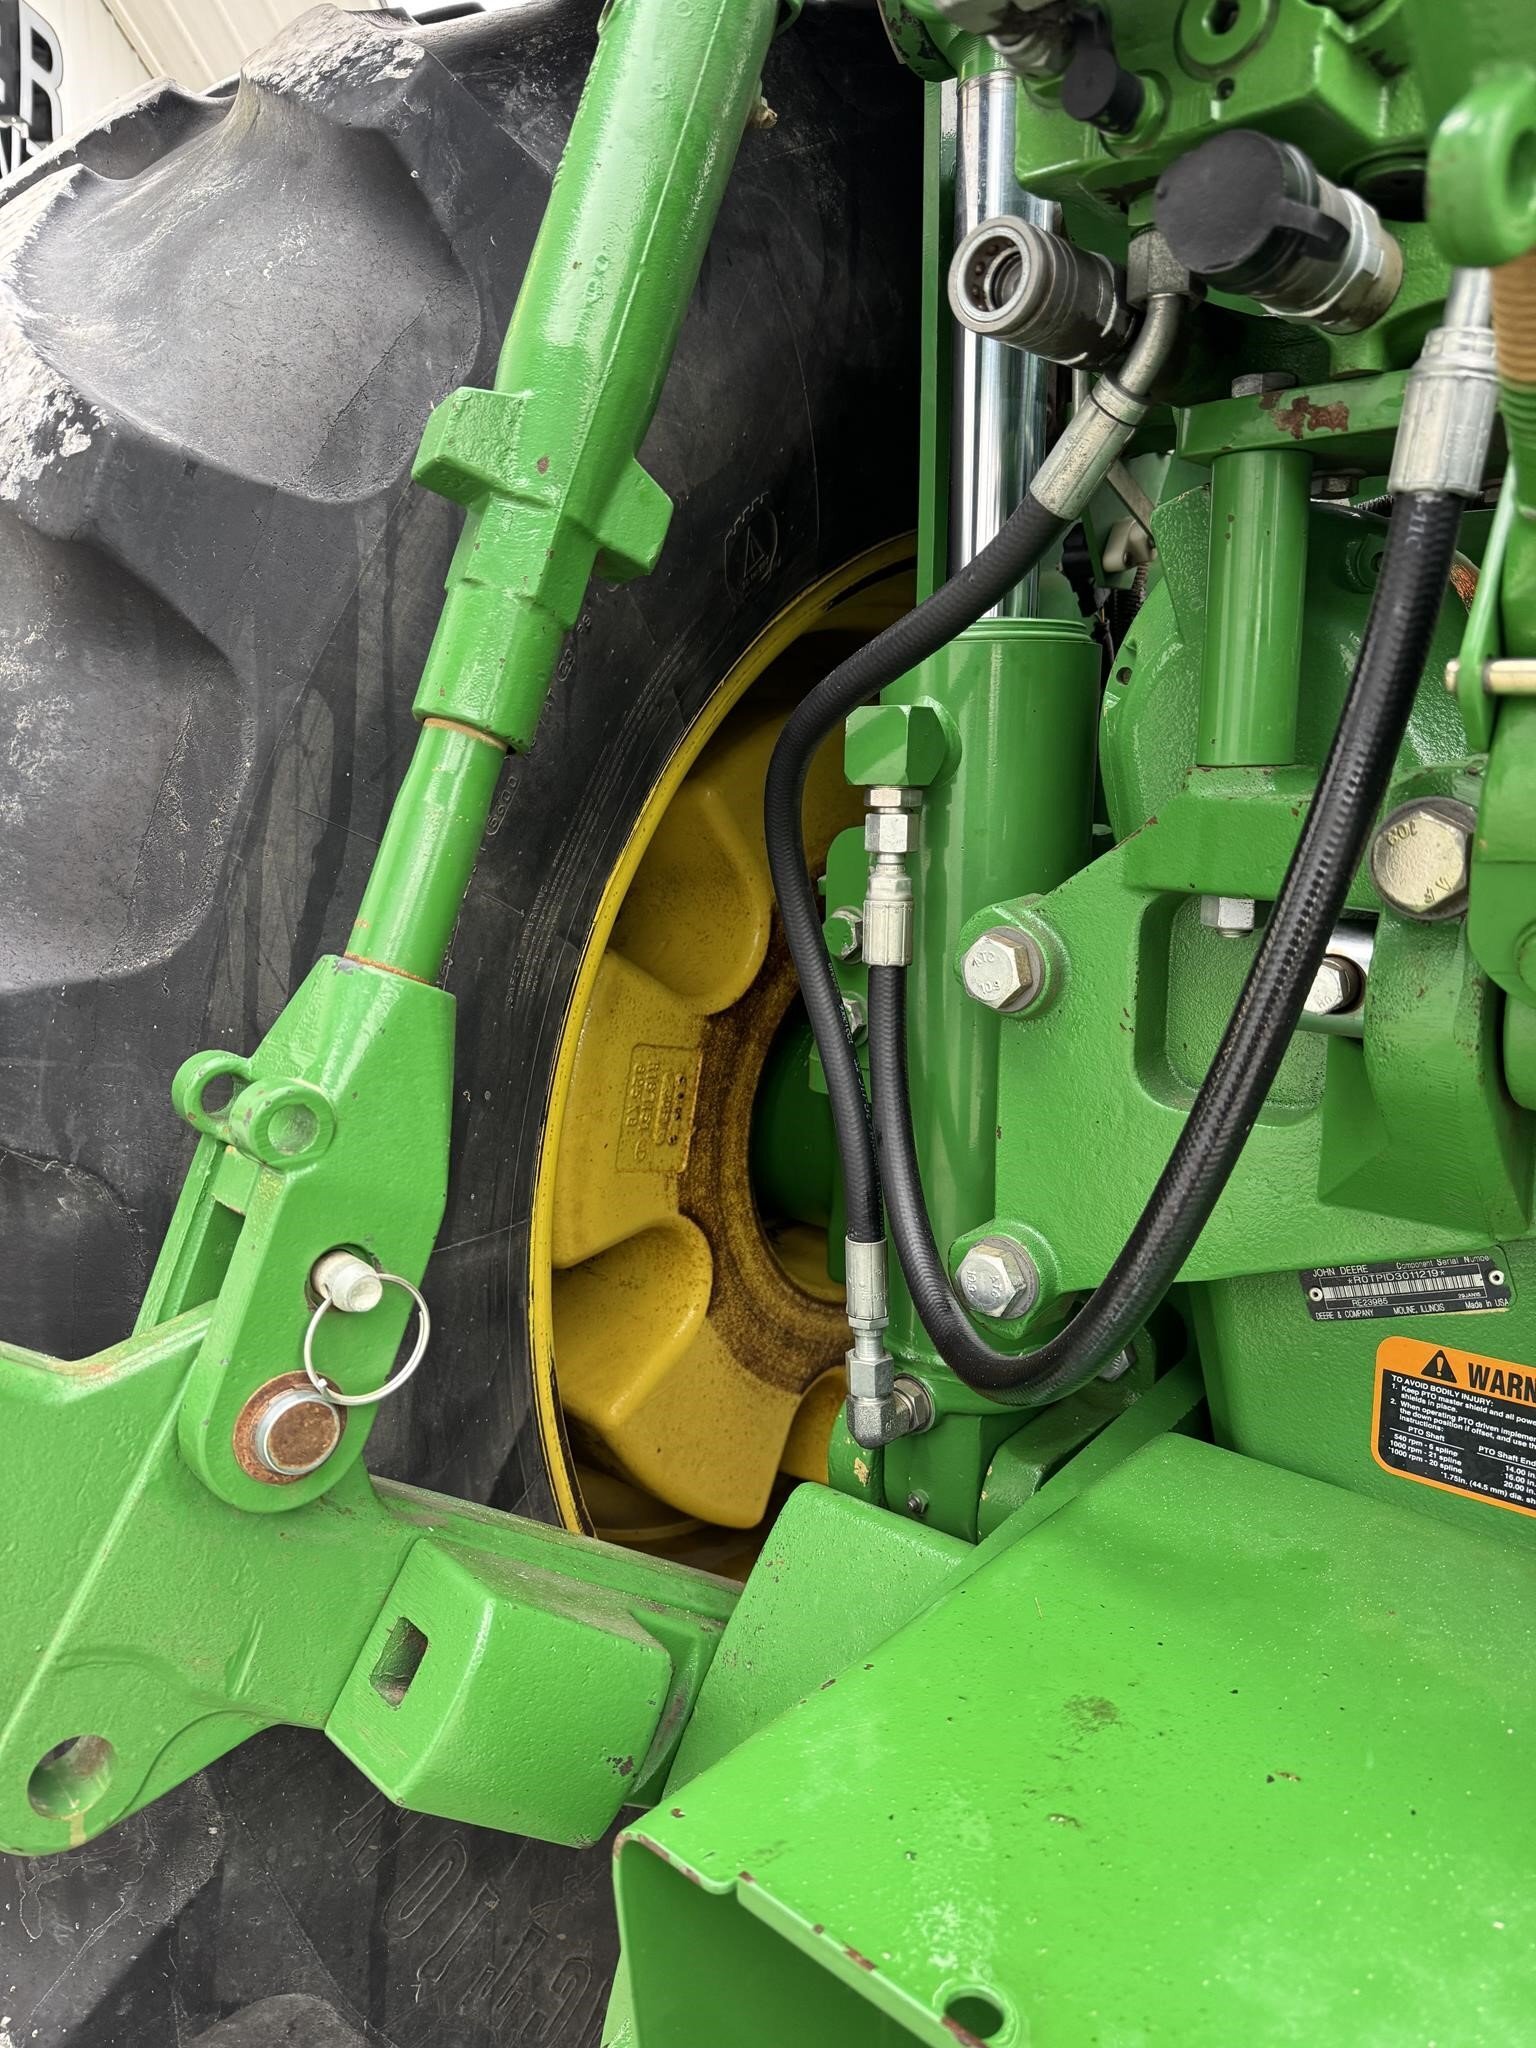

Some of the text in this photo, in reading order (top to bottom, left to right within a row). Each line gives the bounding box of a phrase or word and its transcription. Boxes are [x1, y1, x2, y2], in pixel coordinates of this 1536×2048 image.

[1313, 1265, 1368, 1277] JOHN DEERE
[1396, 1260, 1433, 1270] Component
[1437, 1258, 1459, 1266] Serial
[1420, 1303, 1445, 1313] ILLINOIS
[1465, 1301, 1482, 1309] Made
[1494, 1298, 1509, 1307] USA
[1315, 1311, 1334, 1320] DEERE
[1345, 1309, 1374, 1318] COMPANY
[1391, 1374, 1494, 1407] TO AVOID BODILY INJURY:
[1468, 1363, 1536, 1403] WARN
[1401, 1386, 1420, 1396] Keep
[1421, 1391, 1436, 1399] PTO
[1438, 1396, 1463, 1407] master
[1465, 1403, 1488, 1413] shield
[1489, 1409, 1504, 1417] and
[1401, 1393, 1426, 1403] shields
[1436, 1402, 1458, 1413] place.
[1399, 1414, 1444, 1431] instructions:
[1400, 1401, 1420, 1411] When
[1422, 1407, 1457, 1422] operating
[1458, 1416, 1474, 1425] PTO
[1475, 1421, 1500, 1432] driven
[1408, 1426, 1445, 1441] PTO Shaft
[1412, 1411, 1432, 1421] down
[1433, 1418, 1463, 1431] position
[1465, 1423, 1470, 1431] if
[1471, 1427, 1495, 1439] offset,
[1496, 1434, 1511, 1443] and
[1513, 1439, 1527, 1447] use
[1390, 1440, 1407, 1449] 1000
[1408, 1445, 1422, 1454] rpm
[1439, 1455, 1462, 1466] spline
[1394, 1433, 1407, 1442] 540
[1408, 1438, 1423, 1447] rpm
[1435, 1446, 1458, 1457] spline
[1478, 1446, 1495, 1455] PTO
[1497, 1451, 1518, 1462] Shaft
[1408, 1453, 1423, 1462] rpm
[1440, 1463, 1463, 1474] spline
[1505, 1465, 1526, 1476] 14.00
[1504, 1473, 1525, 1484] 16.00
[1469, 1480, 1488, 1491] (44.5
[1490, 1486, 1508, 1497] mm)
[1509, 1492, 1524, 1501] dia.
[1503, 1481, 1536, 1495] 20.00 in.
